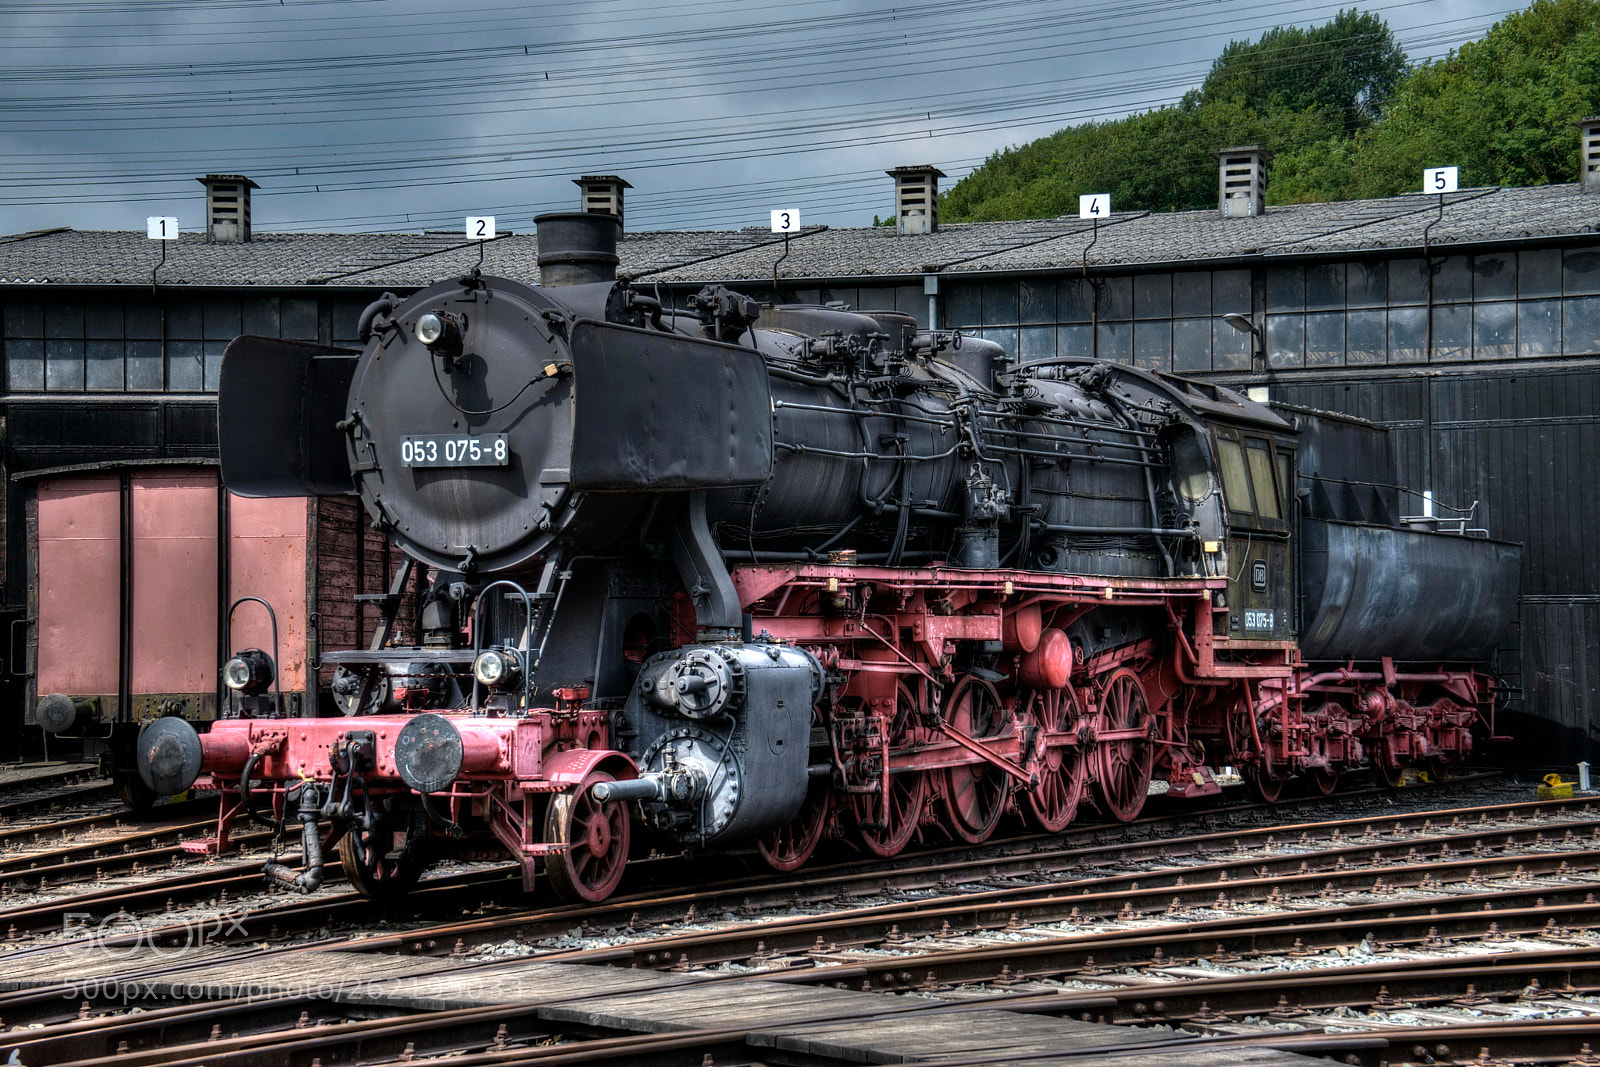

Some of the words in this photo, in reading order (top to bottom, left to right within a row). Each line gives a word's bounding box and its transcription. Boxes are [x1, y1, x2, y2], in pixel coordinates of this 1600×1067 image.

[1434, 171, 1446, 190] 5
[1089, 197, 1100, 215] 4
[159, 219, 166, 237] 1
[475, 219, 486, 236] 2
[780, 212, 791, 229] 3
[402, 441, 438, 462] 053
[445, 439, 506, 461] 075-8
[1245, 612, 1256, 627] 053
[1256, 612, 1274, 628] 075-8
